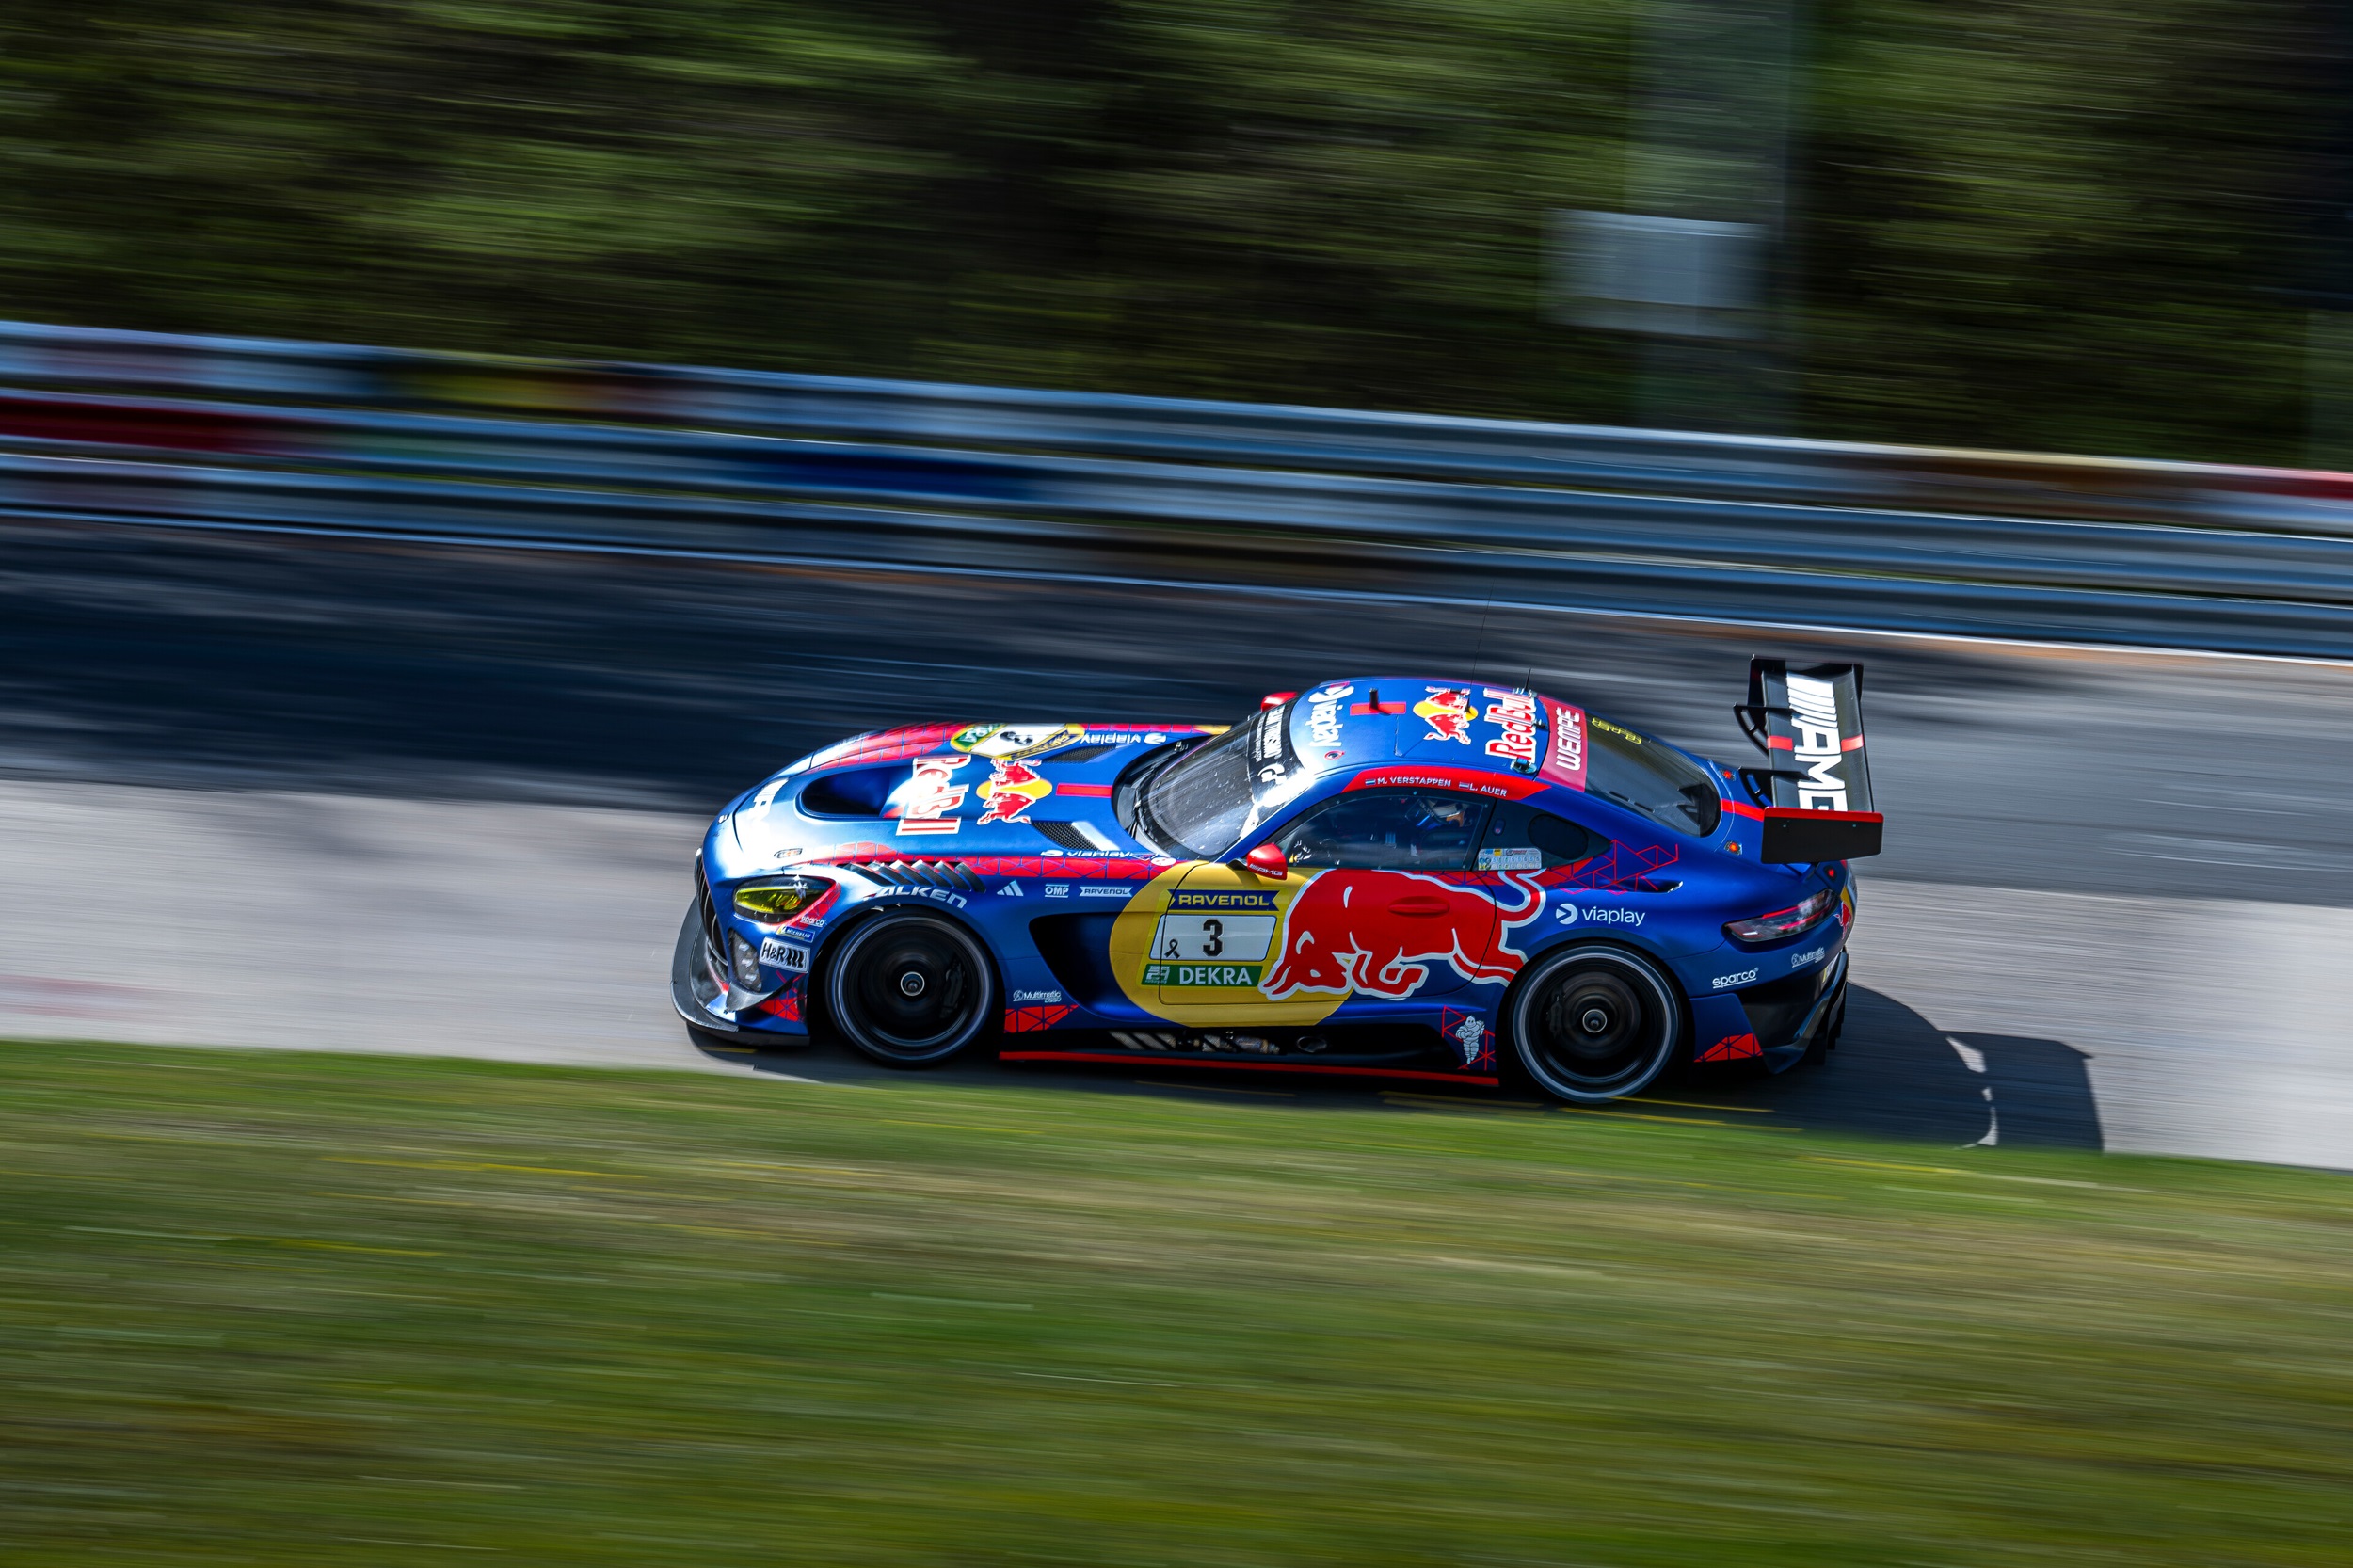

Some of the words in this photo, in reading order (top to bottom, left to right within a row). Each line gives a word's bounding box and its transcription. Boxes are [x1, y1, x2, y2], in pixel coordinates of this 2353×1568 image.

[999, 729, 1034, 747] 3
[1555, 707, 1581, 771] WEMPE
[1377, 776, 1388, 785] M.
[1390, 776, 1451, 788] VERSTAPPEN
[1469, 782, 1478, 792] L.
[1481, 784, 1508, 797] AUER
[1066, 850, 1132, 859] viaplay
[1045, 885, 1069, 896] OMP
[1178, 894, 1270, 906] RAVENOL
[800, 916, 825, 927] sparco
[1581, 905, 1646, 927] viaplay
[1202, 919, 1223, 957] 3
[760, 941, 786, 964] H&R
[1179, 967, 1253, 985] DEKRA
[1712, 969, 1757, 988] sparco
[1023, 990, 1062, 1000] Multimatic
